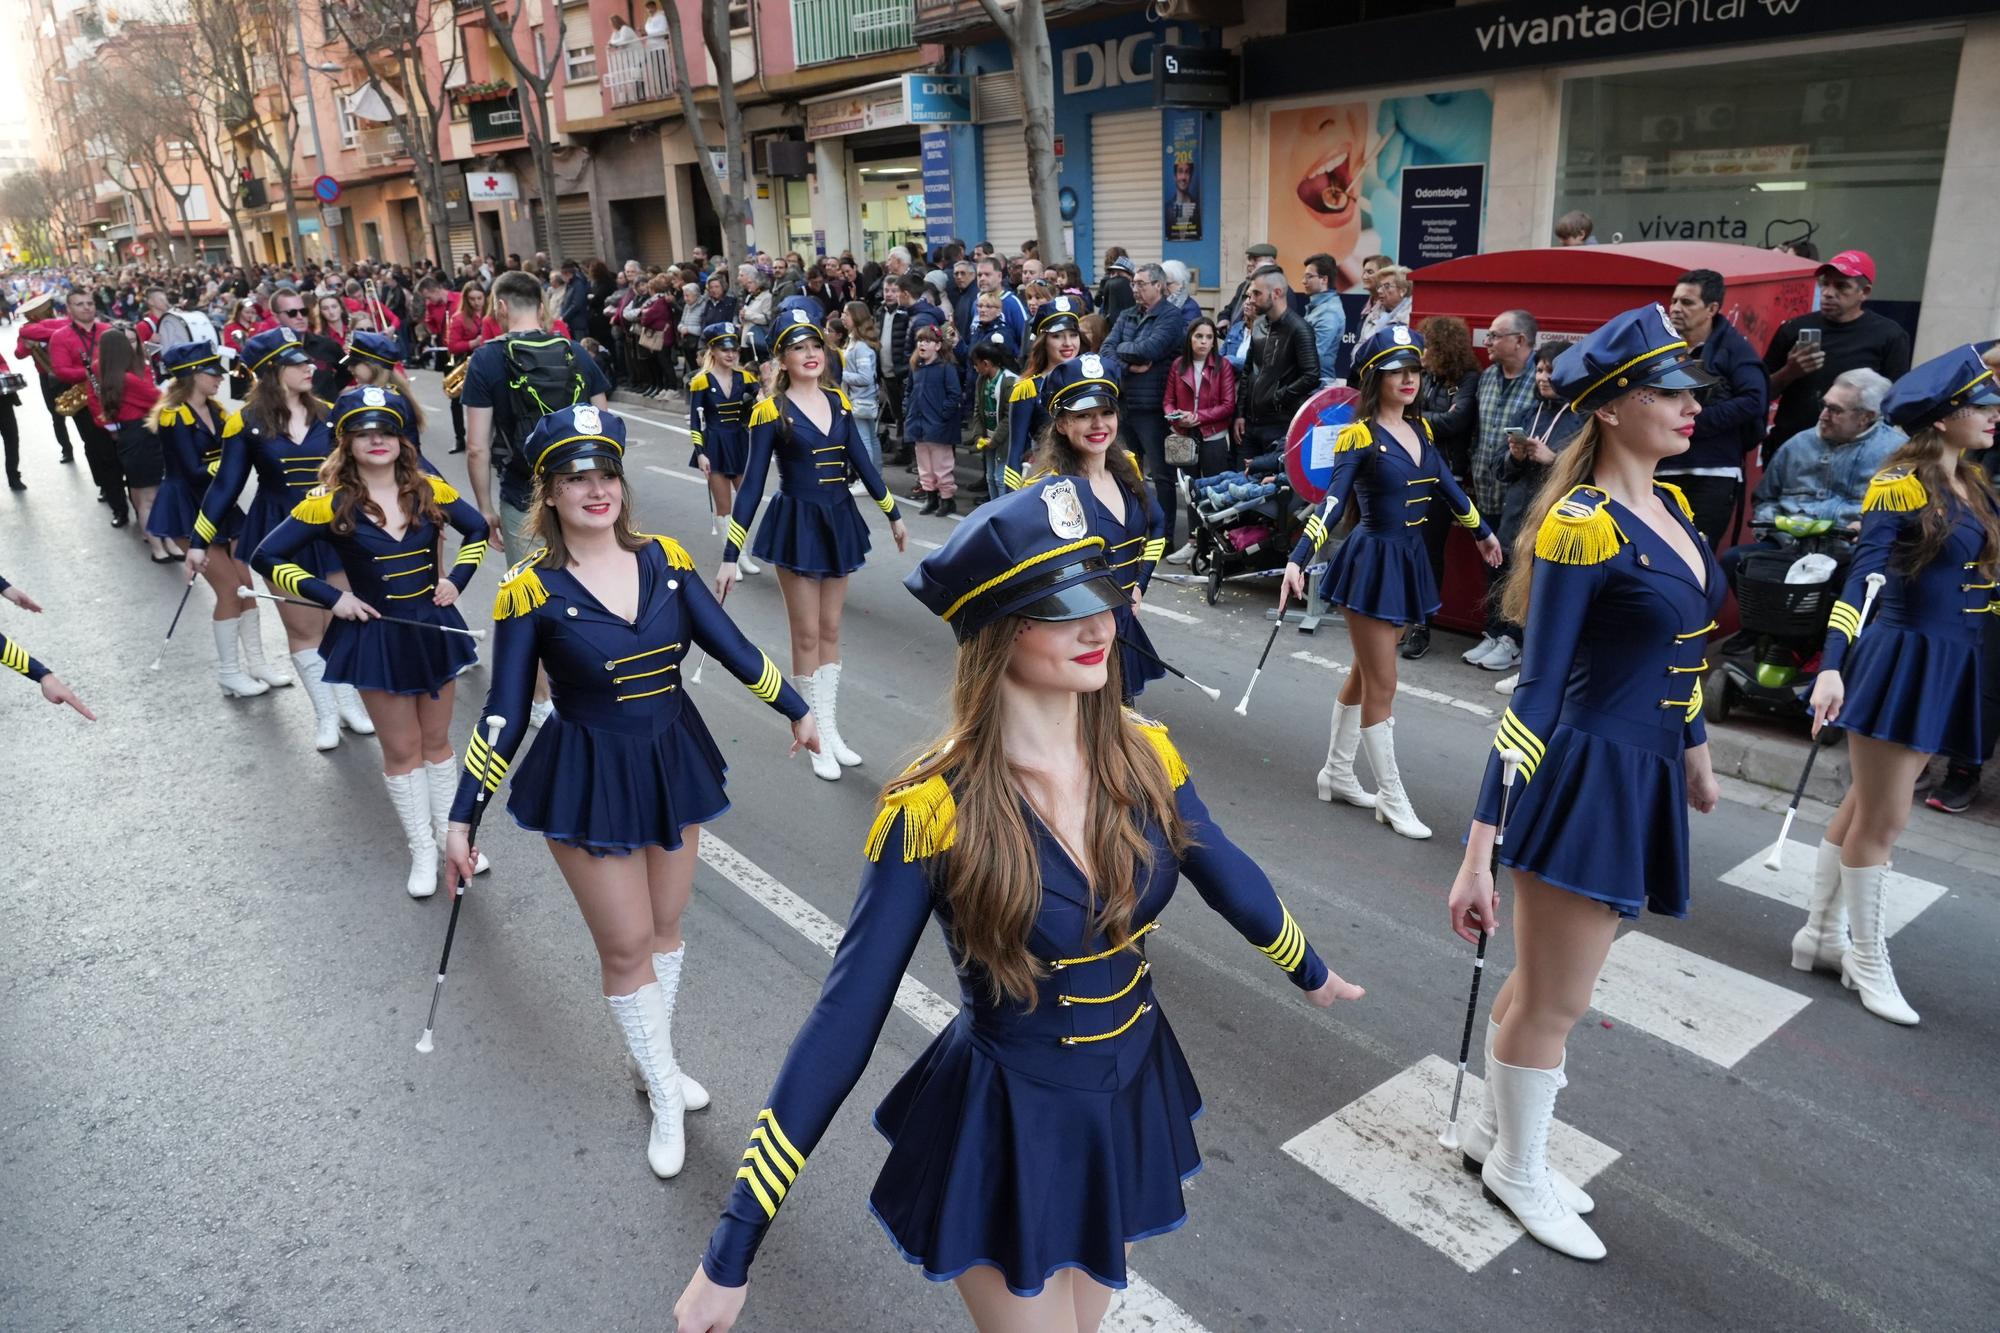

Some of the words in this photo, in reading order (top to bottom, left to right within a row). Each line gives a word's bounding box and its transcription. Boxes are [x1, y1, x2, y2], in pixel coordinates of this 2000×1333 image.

[922, 83, 962, 95] DIGI
[1415, 187, 1467, 199] Odontología
[1638, 215, 1747, 239] vivanta
